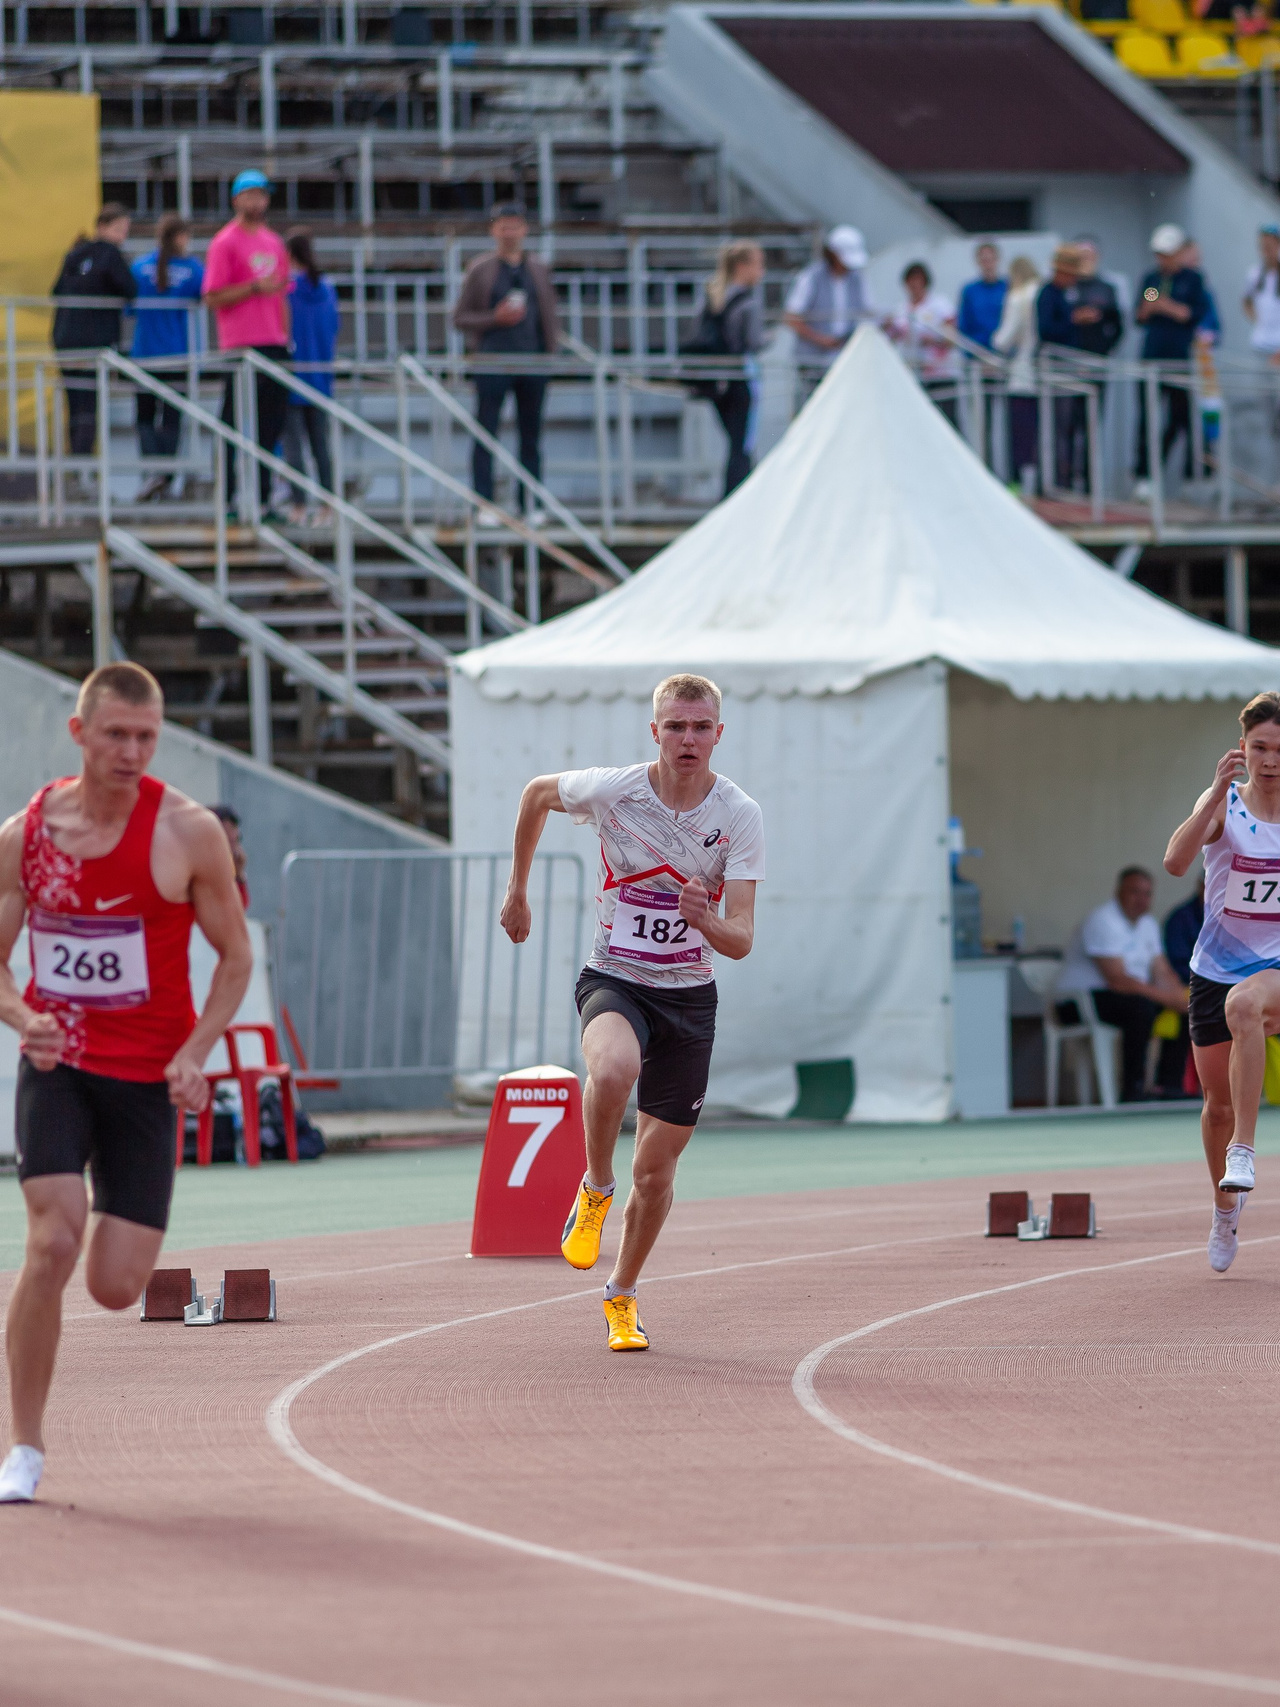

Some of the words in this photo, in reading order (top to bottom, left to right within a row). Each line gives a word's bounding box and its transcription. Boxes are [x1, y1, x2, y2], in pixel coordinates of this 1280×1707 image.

[632, 914, 689, 944] 182
[53, 943, 122, 982] 268
[505, 1087, 569, 1101] MONDO
[507, 1106, 566, 1188] 7
